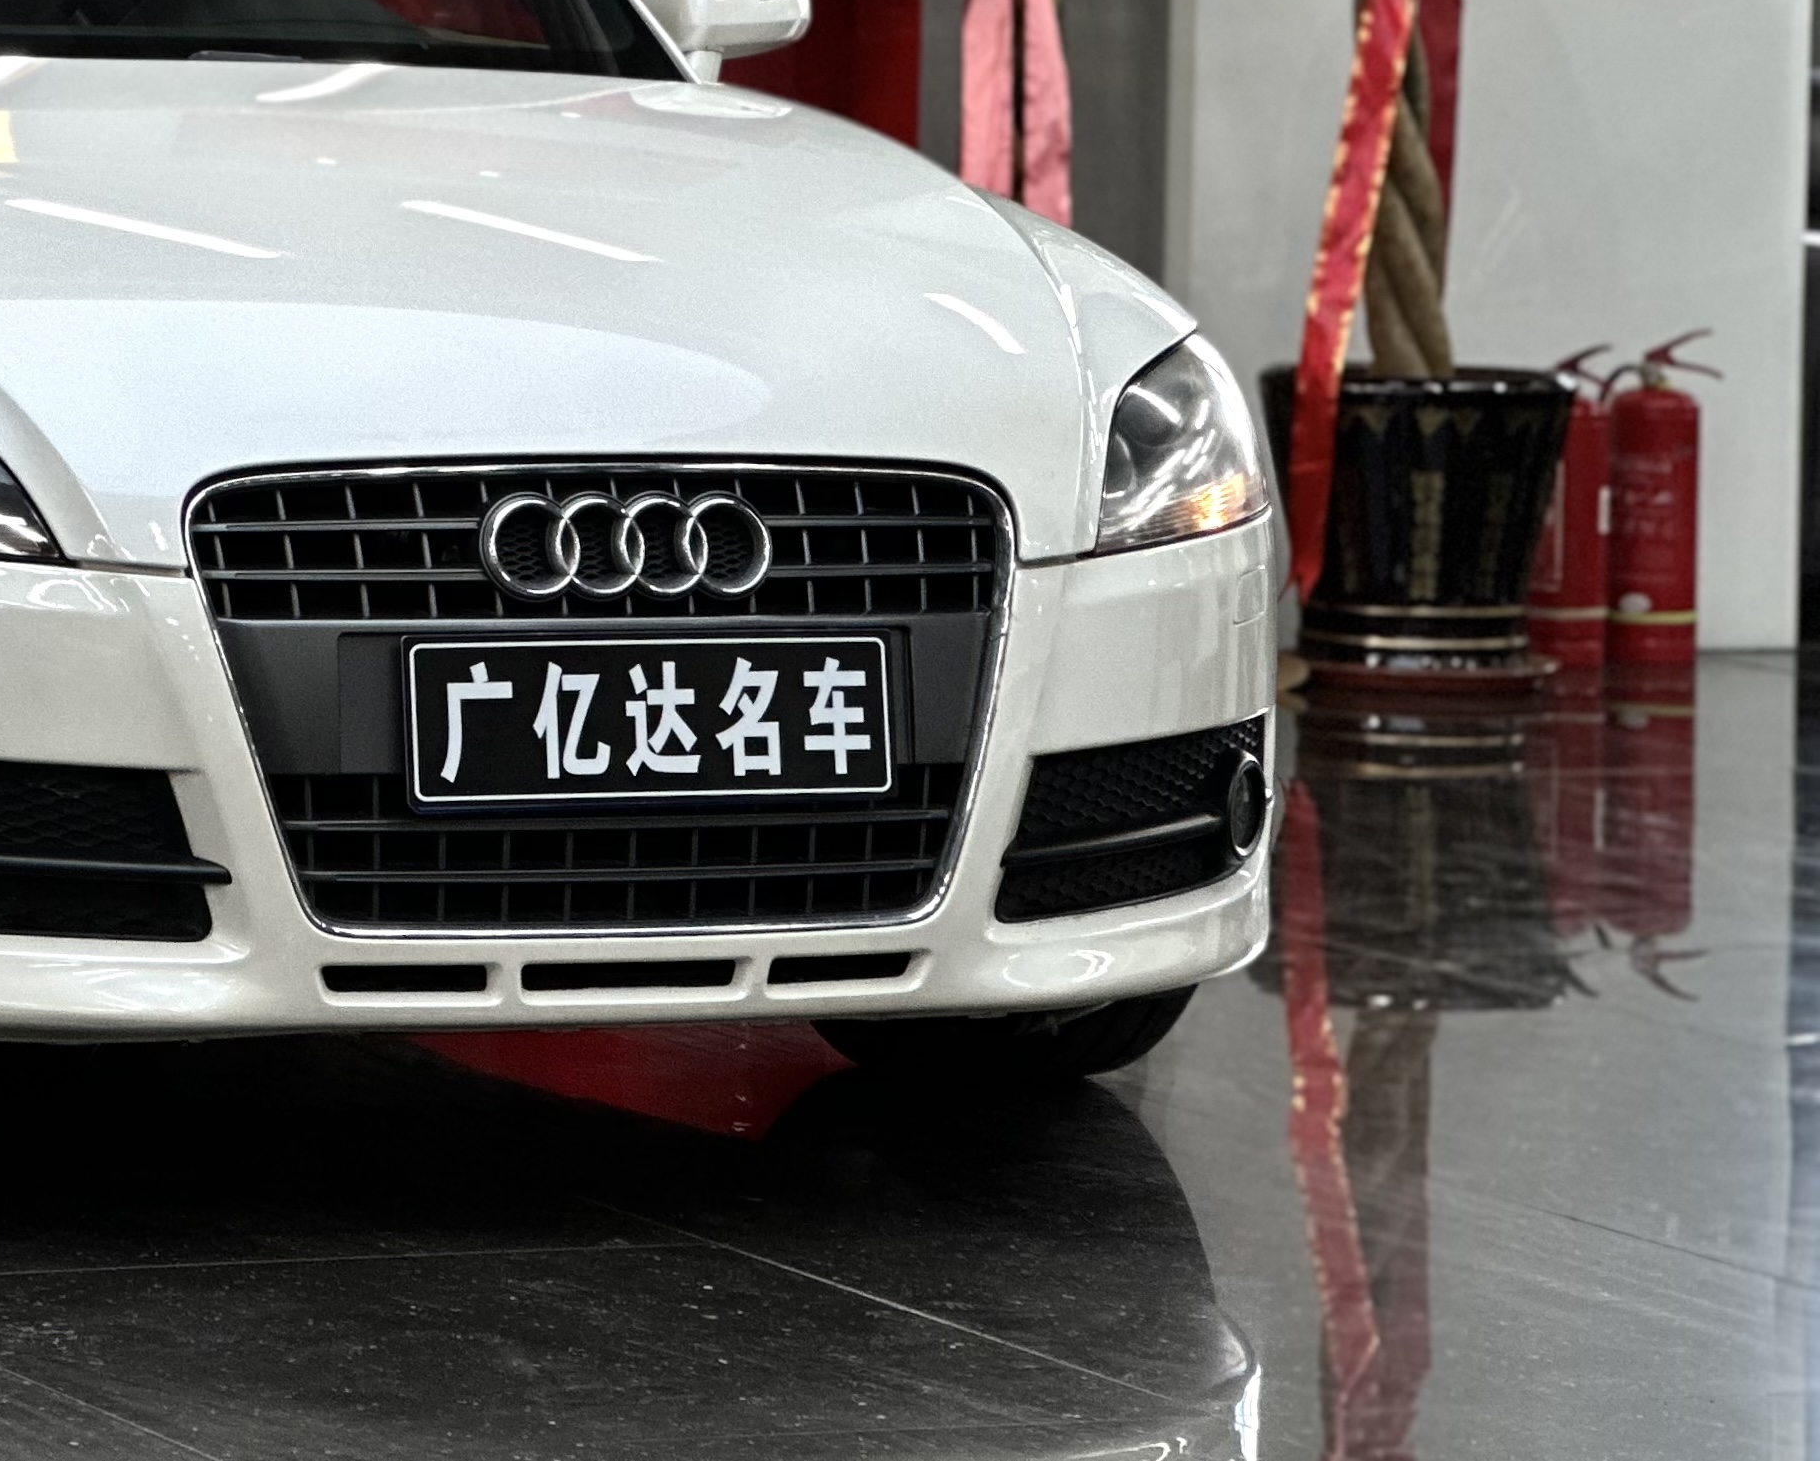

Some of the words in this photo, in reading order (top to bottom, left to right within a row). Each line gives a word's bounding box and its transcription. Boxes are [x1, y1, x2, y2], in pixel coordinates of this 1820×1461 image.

[440, 656, 871, 783] 广亿达名车
